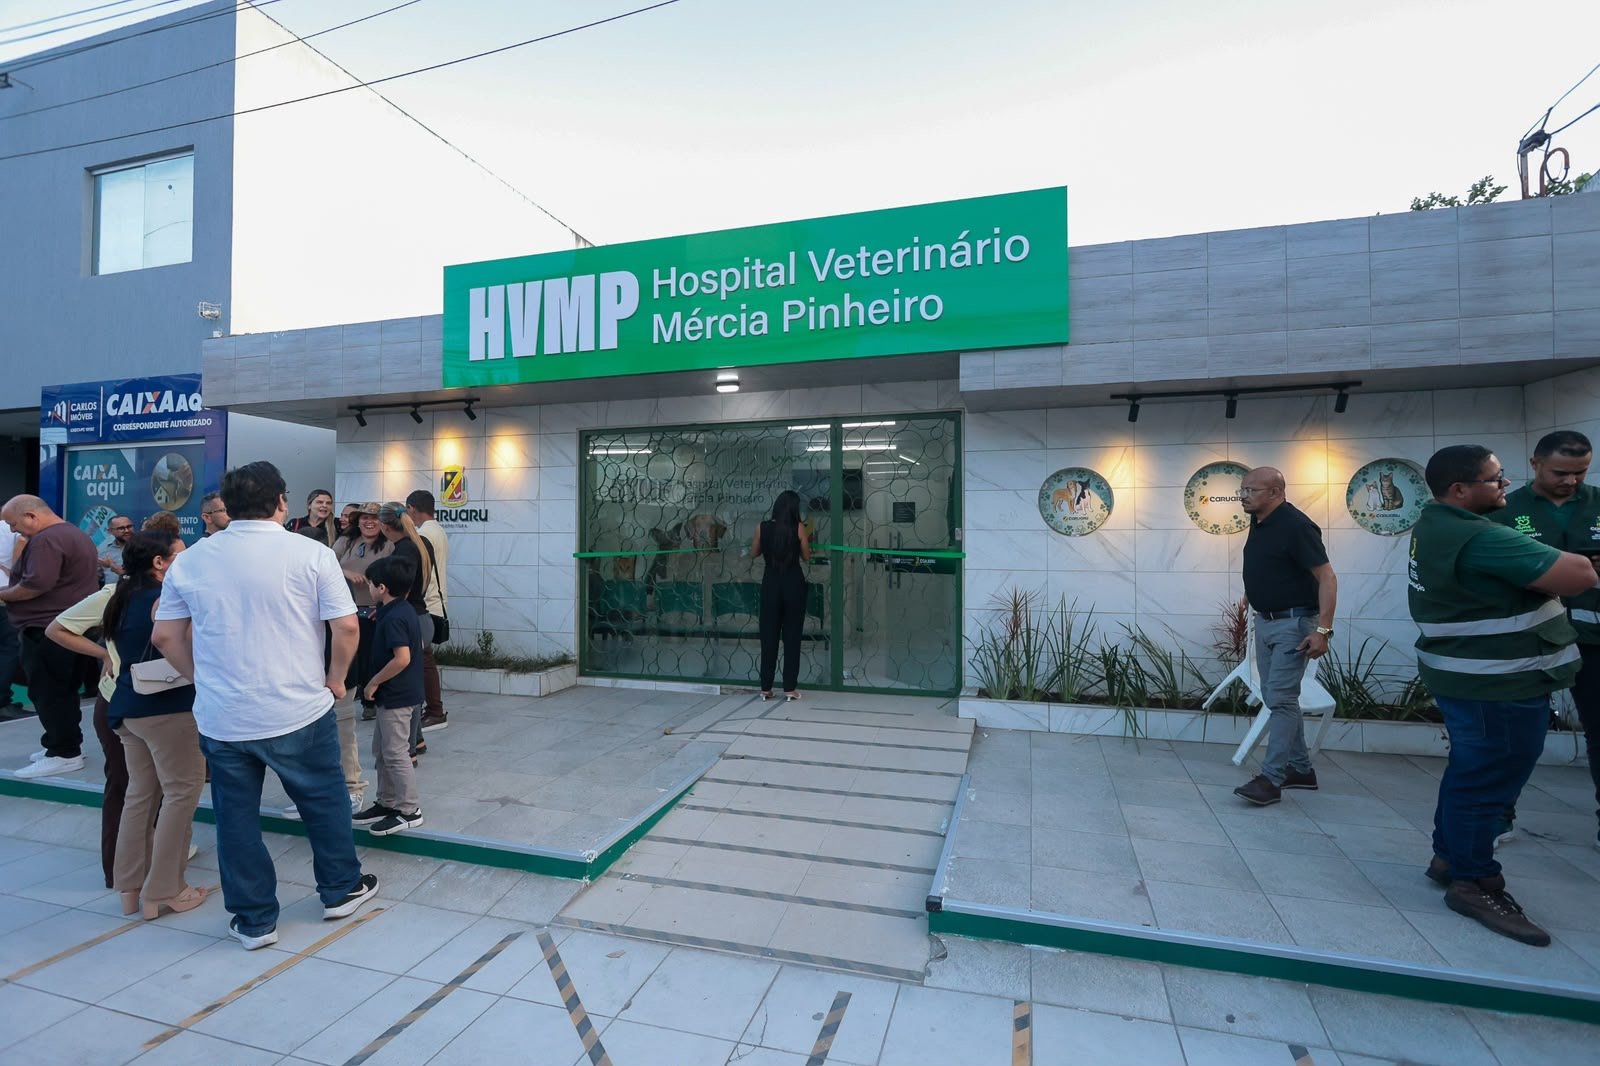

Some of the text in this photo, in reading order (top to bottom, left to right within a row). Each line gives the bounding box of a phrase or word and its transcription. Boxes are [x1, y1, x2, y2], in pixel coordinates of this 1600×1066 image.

[653, 226, 1030, 300] Hospital Veterinário
[469, 270, 640, 361] HVMP
[653, 288, 944, 344] Mércia Pinheiro
[70, 401, 97, 412] CARLOS
[106, 390, 203, 416] CAIXA AQ
[113, 418, 213, 431] CORRESPONDENTE AUTORIZADO
[73, 464, 118, 481] CAIXA
[86, 475, 125, 501] aqui
